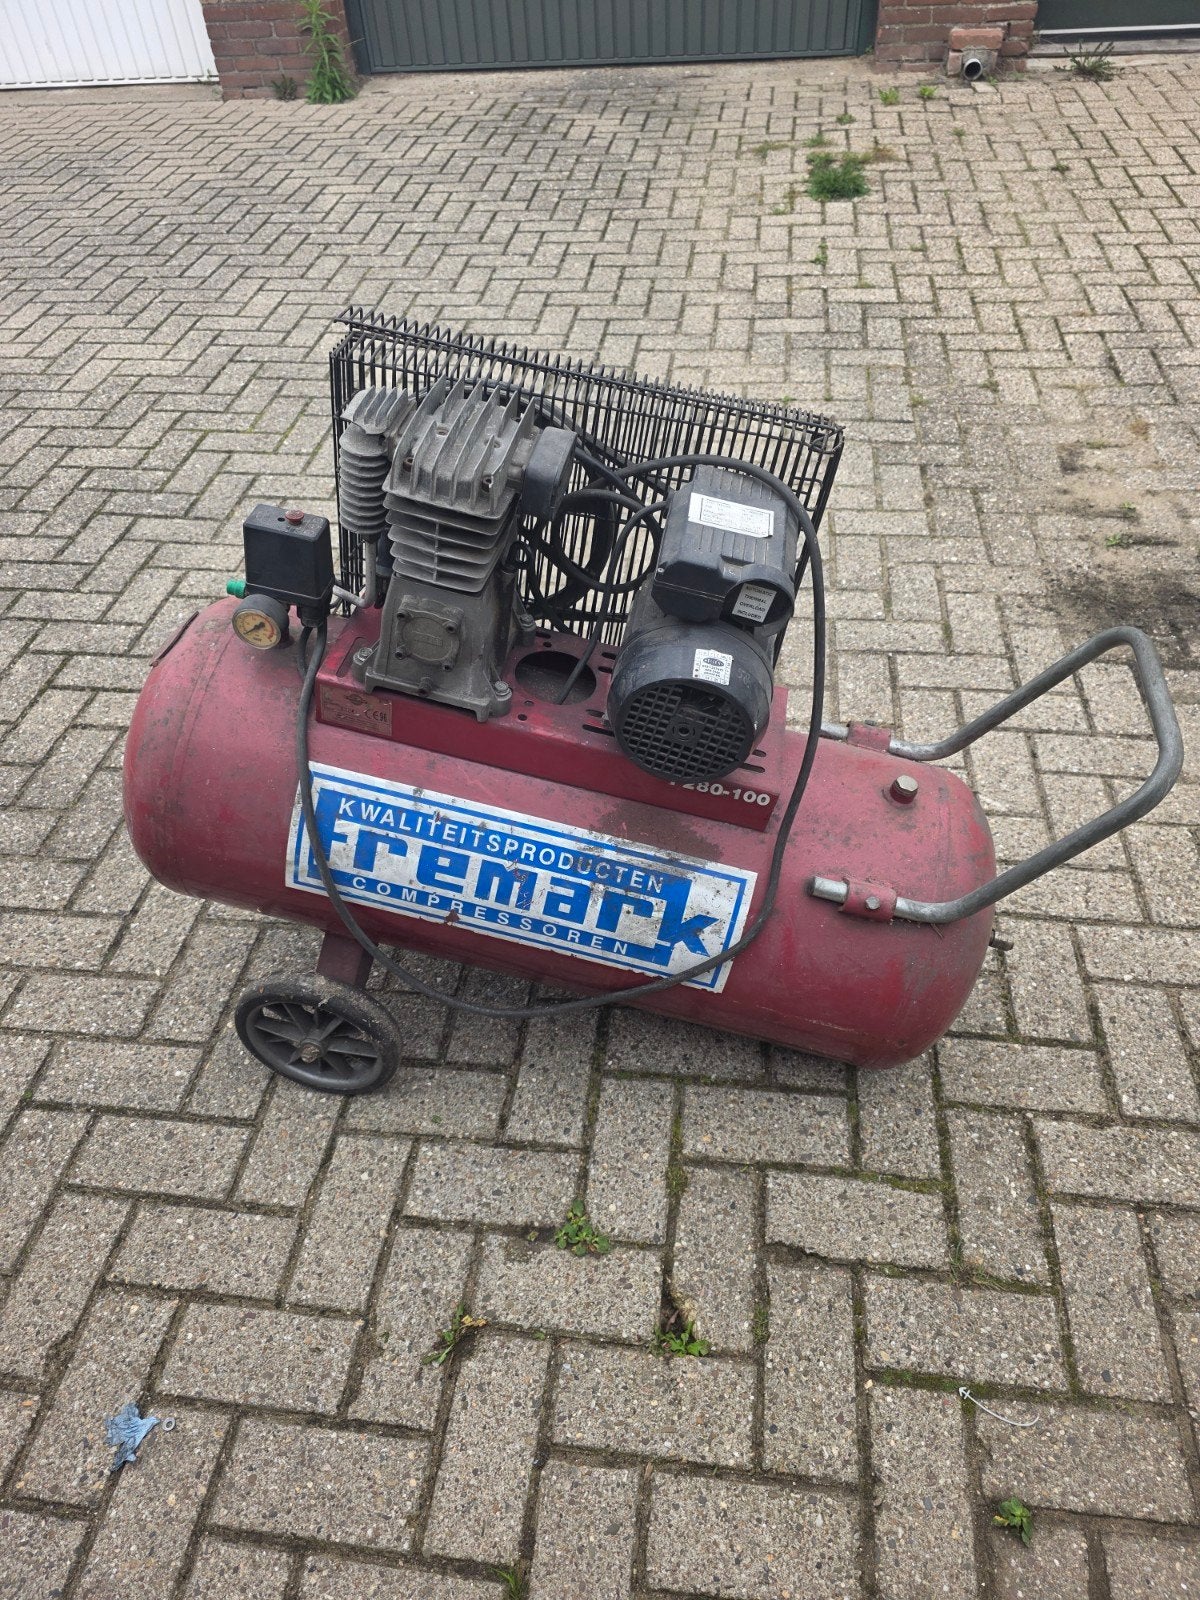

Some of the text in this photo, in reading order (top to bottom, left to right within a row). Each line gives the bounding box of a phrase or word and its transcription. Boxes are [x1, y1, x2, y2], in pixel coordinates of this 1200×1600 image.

[737, 609, 762, 619] INCLUDED
[739, 601, 766, 612] OVERLOAD
[338, 797, 664, 894] KWALITEITSPRODUCTEN
[352, 876, 628, 955] COMPRESSOREN
